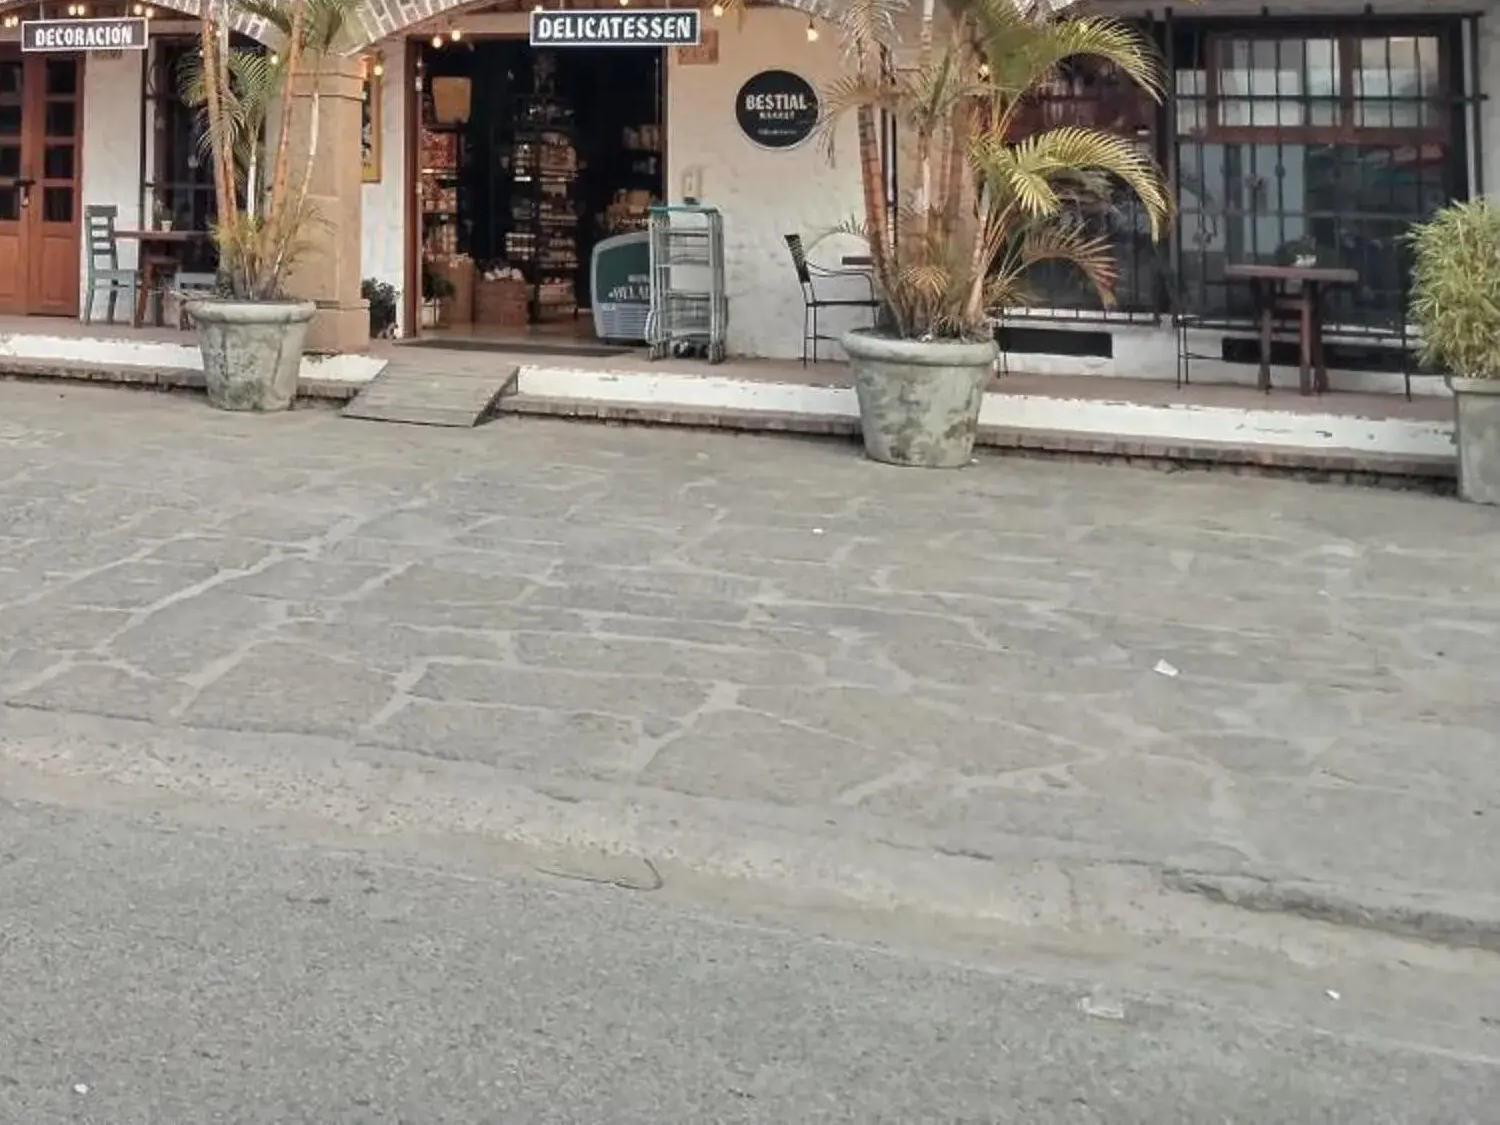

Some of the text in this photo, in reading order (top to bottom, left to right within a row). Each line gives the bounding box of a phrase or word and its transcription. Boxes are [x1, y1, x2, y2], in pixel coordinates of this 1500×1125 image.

[35, 23, 133, 46] DECORACIÓN
[538, 17, 692, 39] DELICATESSEN
[746, 93, 808, 110] BESTIAL
